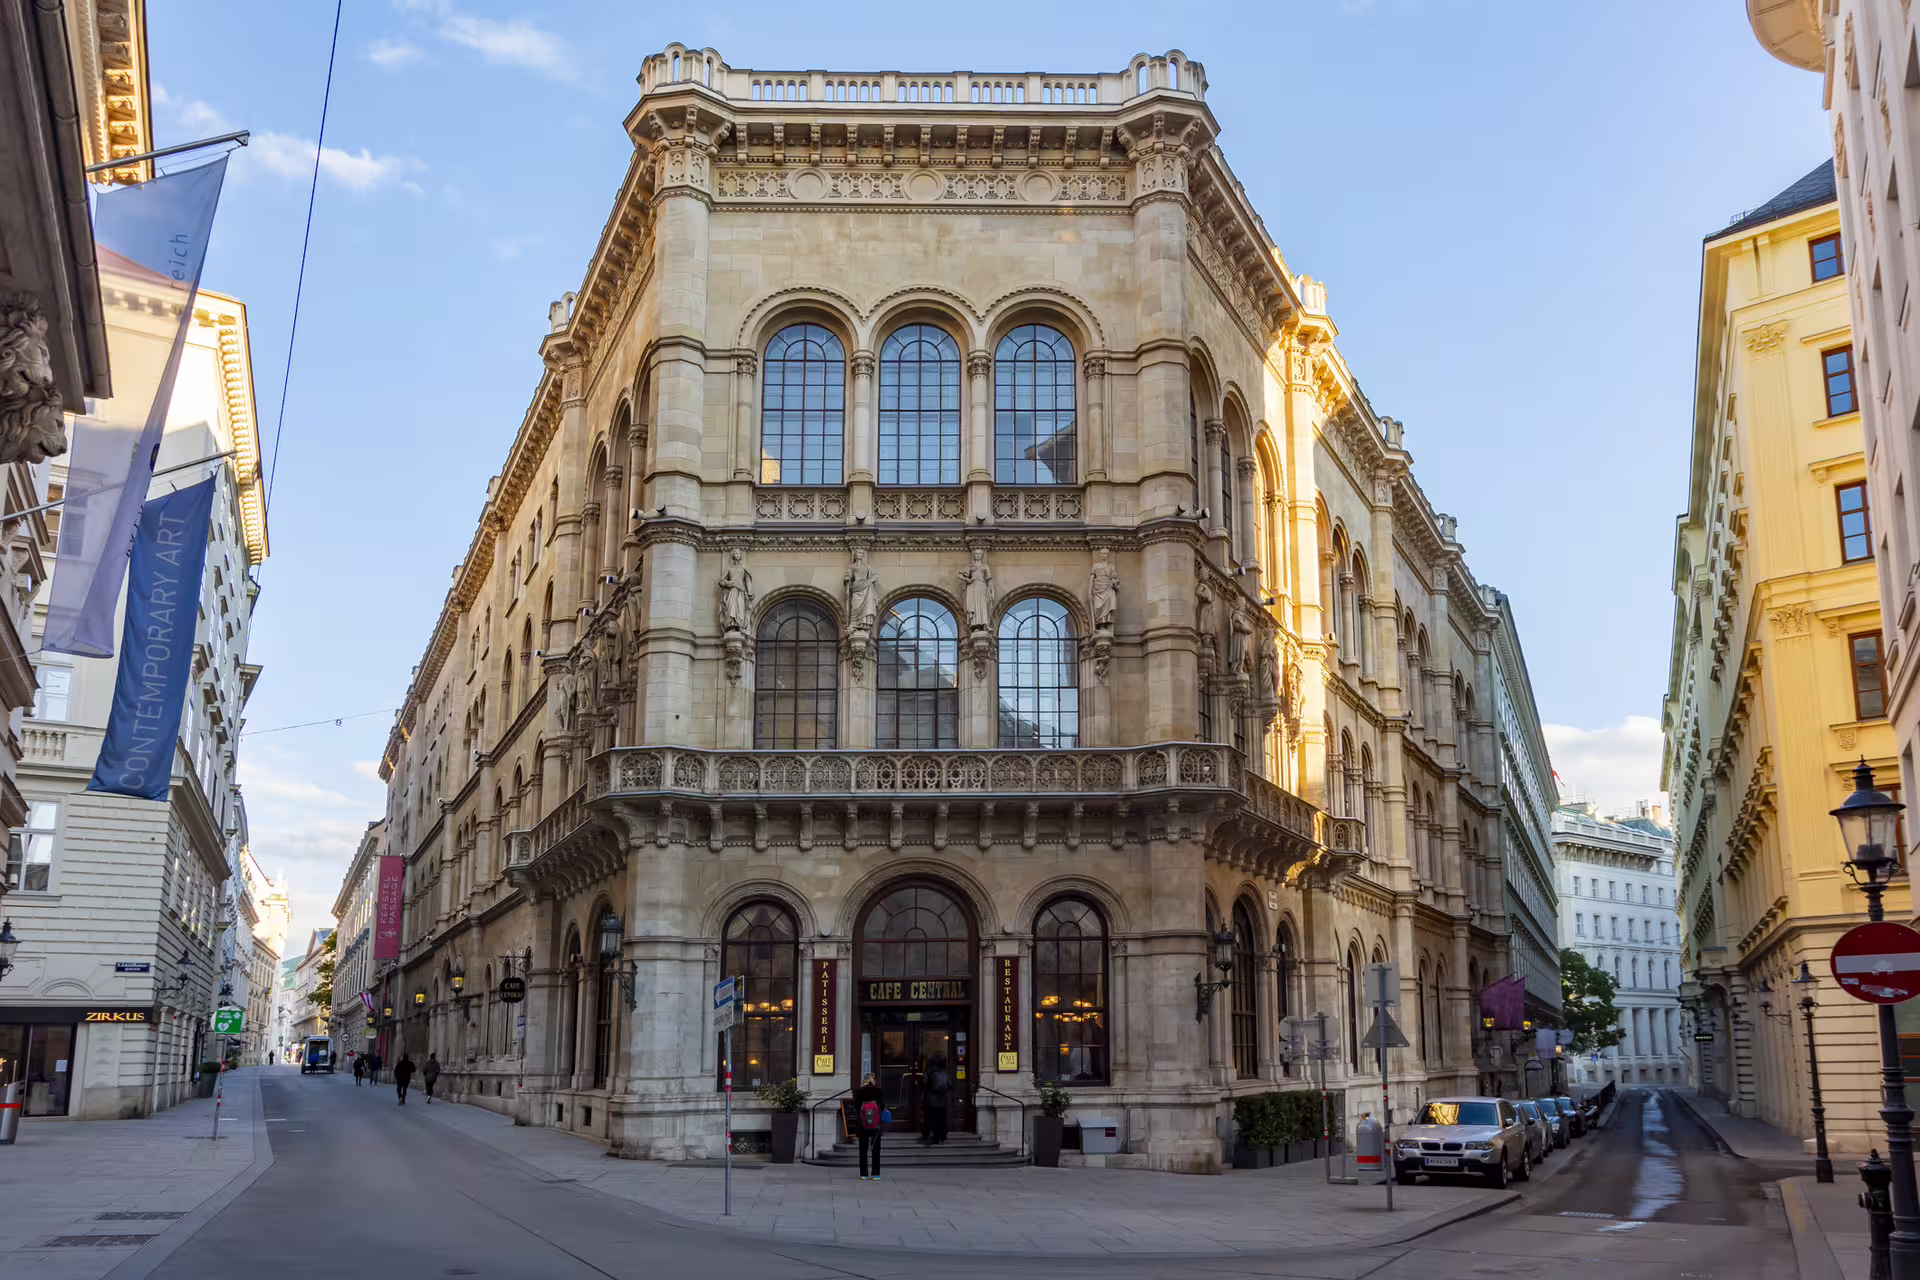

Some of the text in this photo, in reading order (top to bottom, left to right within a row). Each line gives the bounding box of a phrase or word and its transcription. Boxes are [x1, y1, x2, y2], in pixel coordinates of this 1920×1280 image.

[119, 571, 179, 789] CONTEMPORARY
[155, 512, 185, 567] ART
[381, 876, 390, 924] FERSTEL
[389, 875, 398, 924] PASSAGE
[821, 961, 829, 1053] PATISSERIE
[911, 981, 966, 999] CENTRAL
[1004, 959, 1012, 1050] RESTAURANT
[85, 1012, 145, 1021] ZIRKUS
